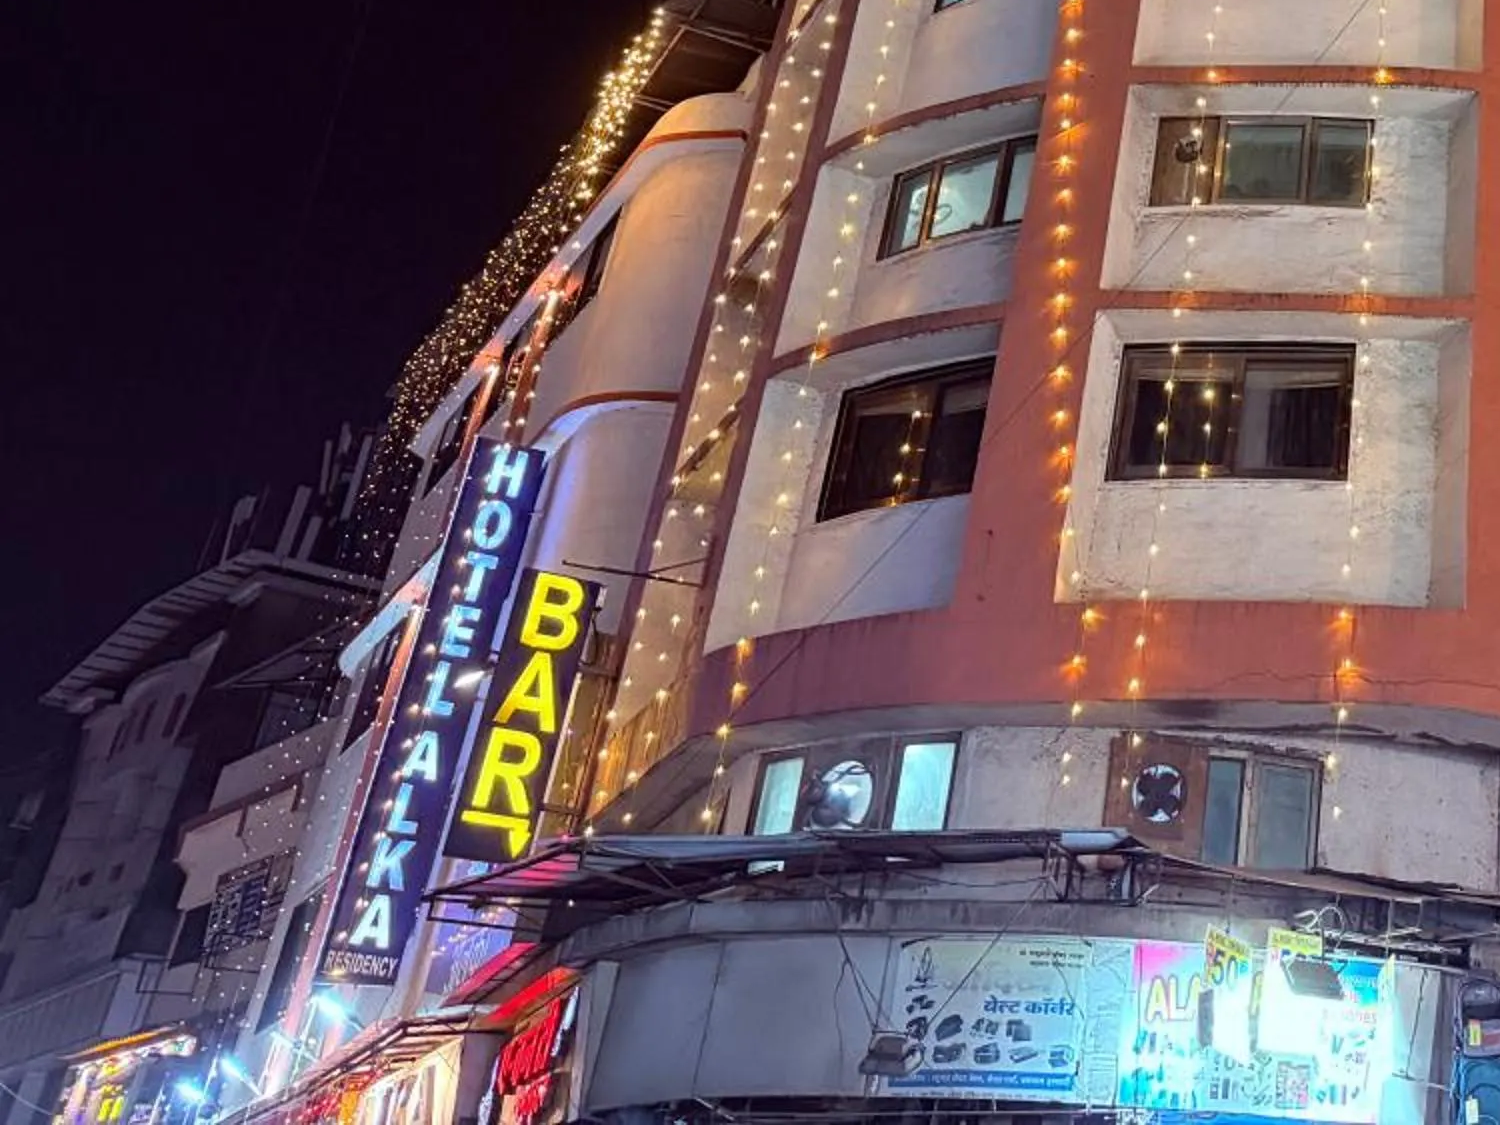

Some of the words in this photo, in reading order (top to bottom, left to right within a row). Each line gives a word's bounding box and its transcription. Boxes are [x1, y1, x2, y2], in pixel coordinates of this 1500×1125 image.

[423, 449, 529, 716] HOTEL
[470, 571, 585, 815] BAR
[349, 731, 439, 950] ALKA
[324, 950, 398, 979] RESIDENCY
